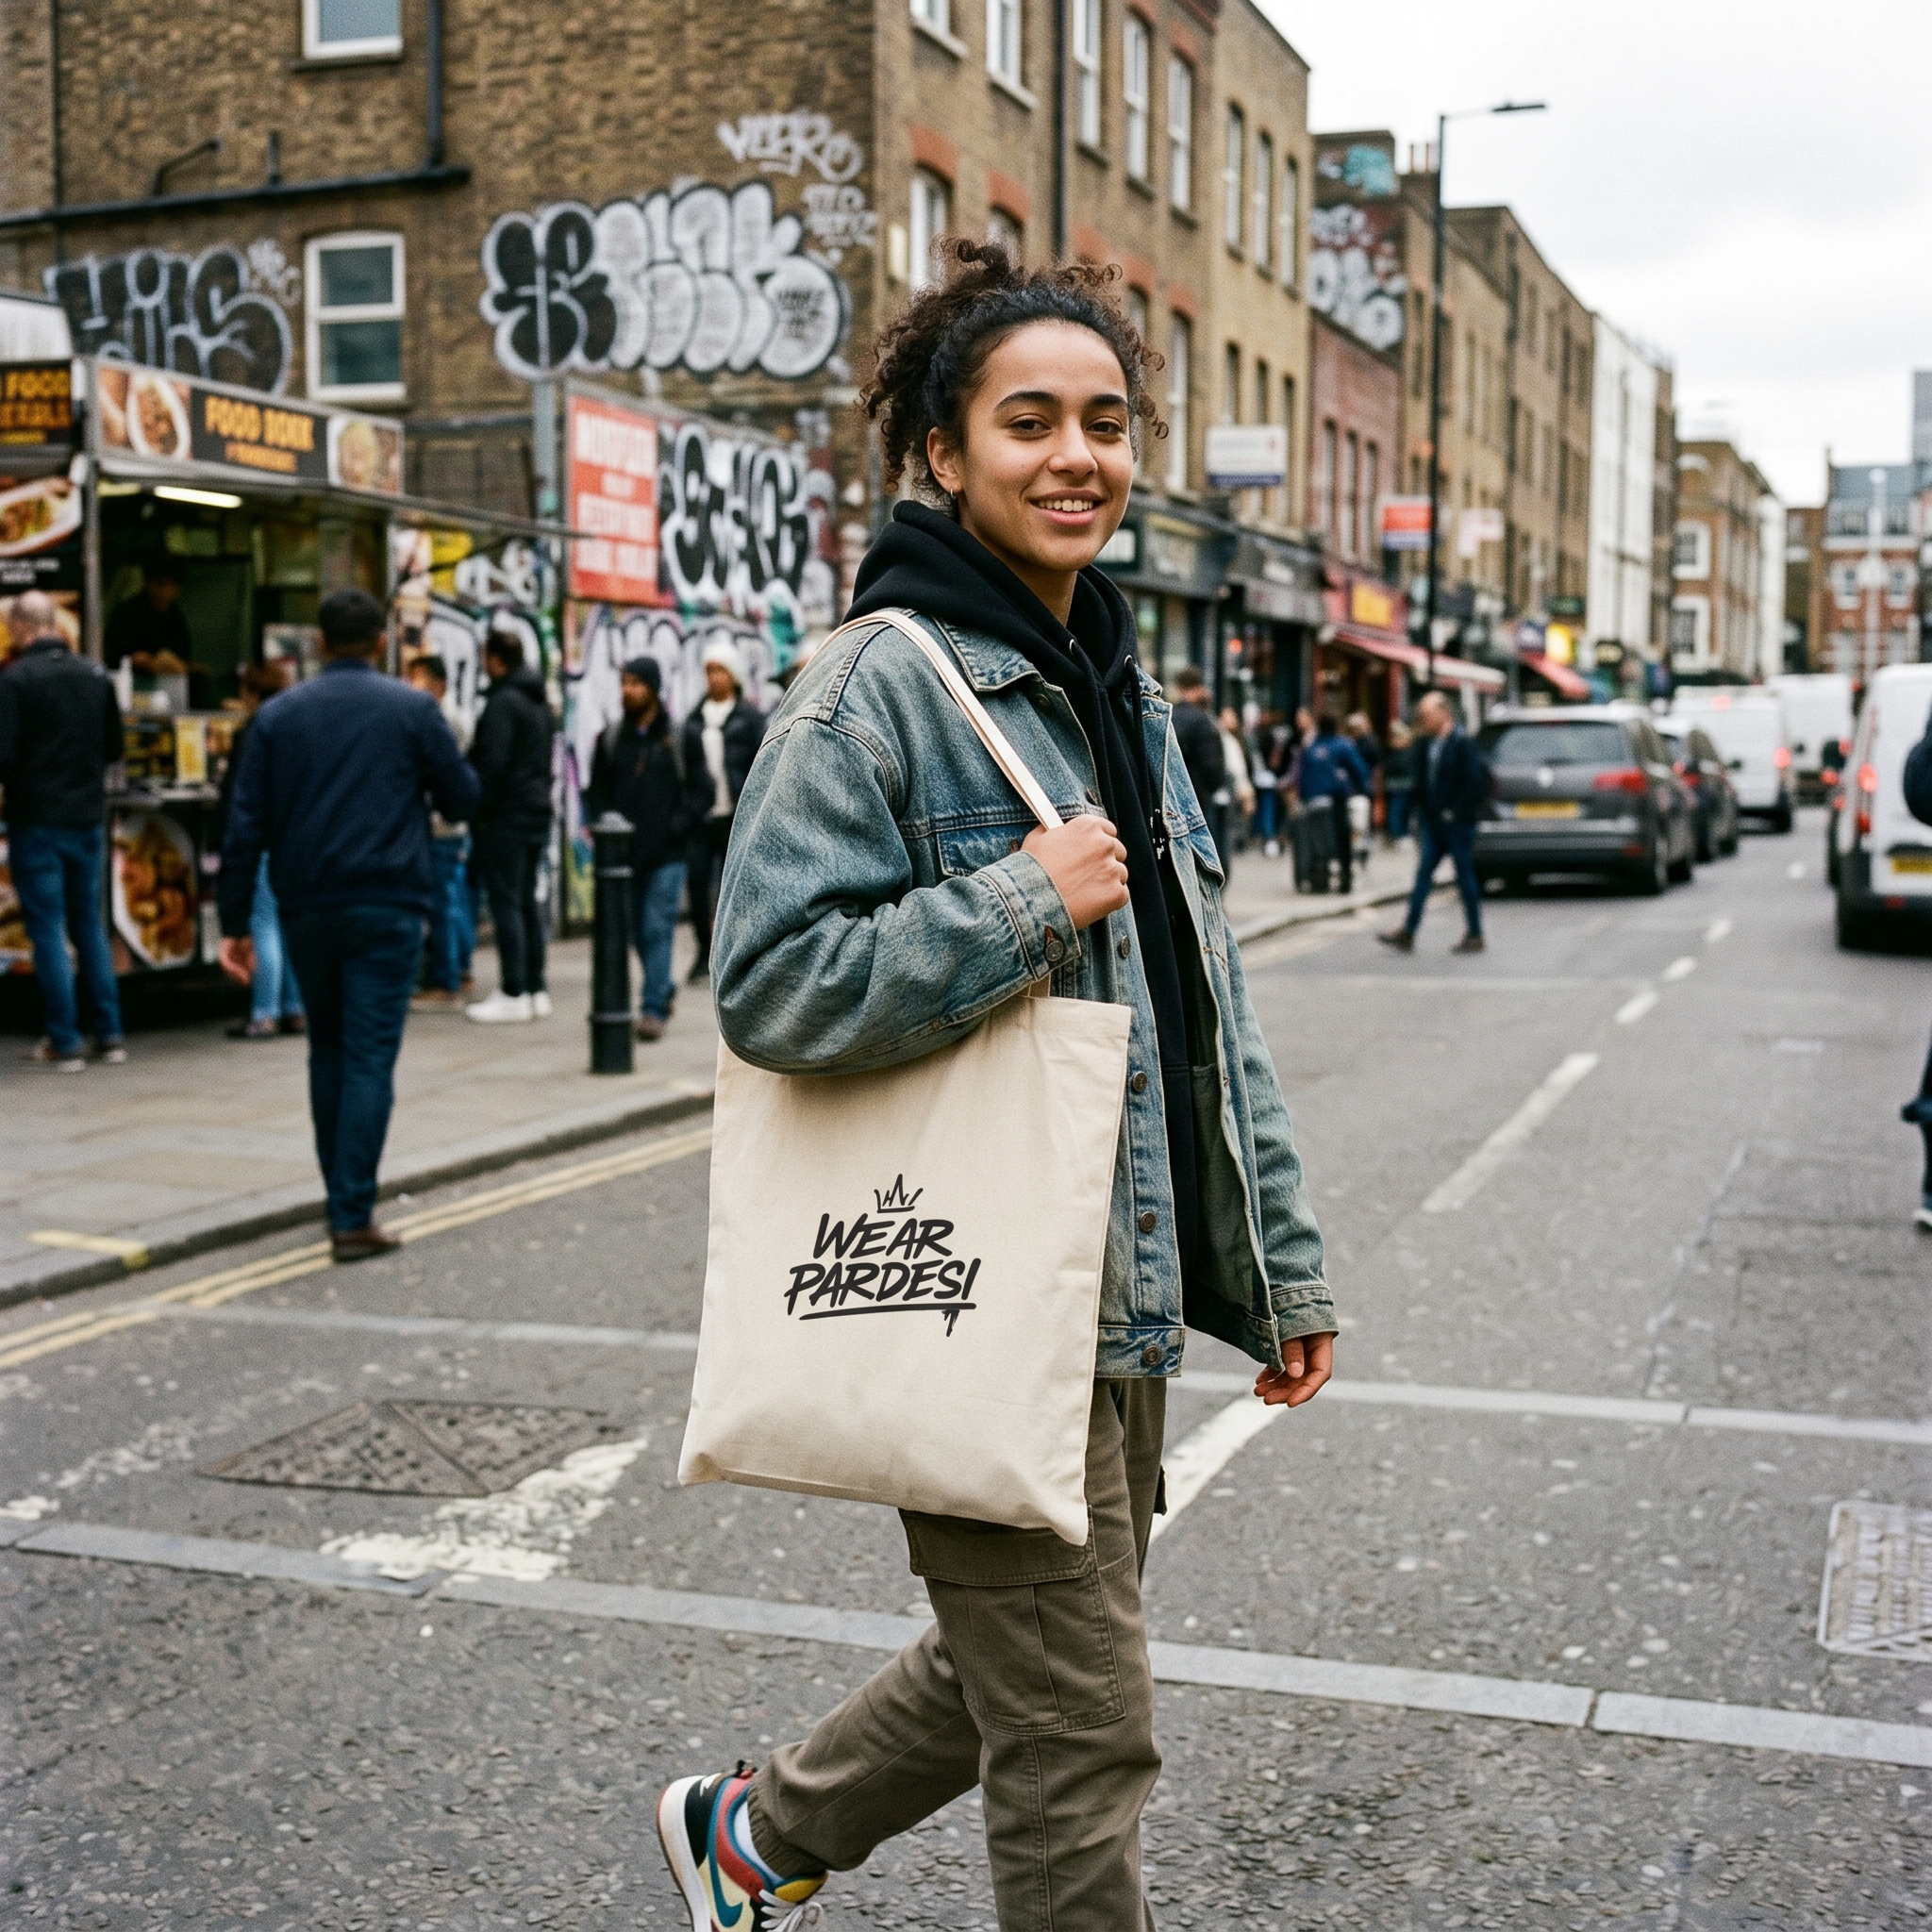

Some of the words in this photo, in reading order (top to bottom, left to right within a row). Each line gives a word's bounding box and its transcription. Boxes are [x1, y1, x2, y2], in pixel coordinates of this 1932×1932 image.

[205, 393, 262, 443] FOOD
[813, 1213, 955, 1259] WEAR
[784, 1257, 982, 1316] PARDESI
